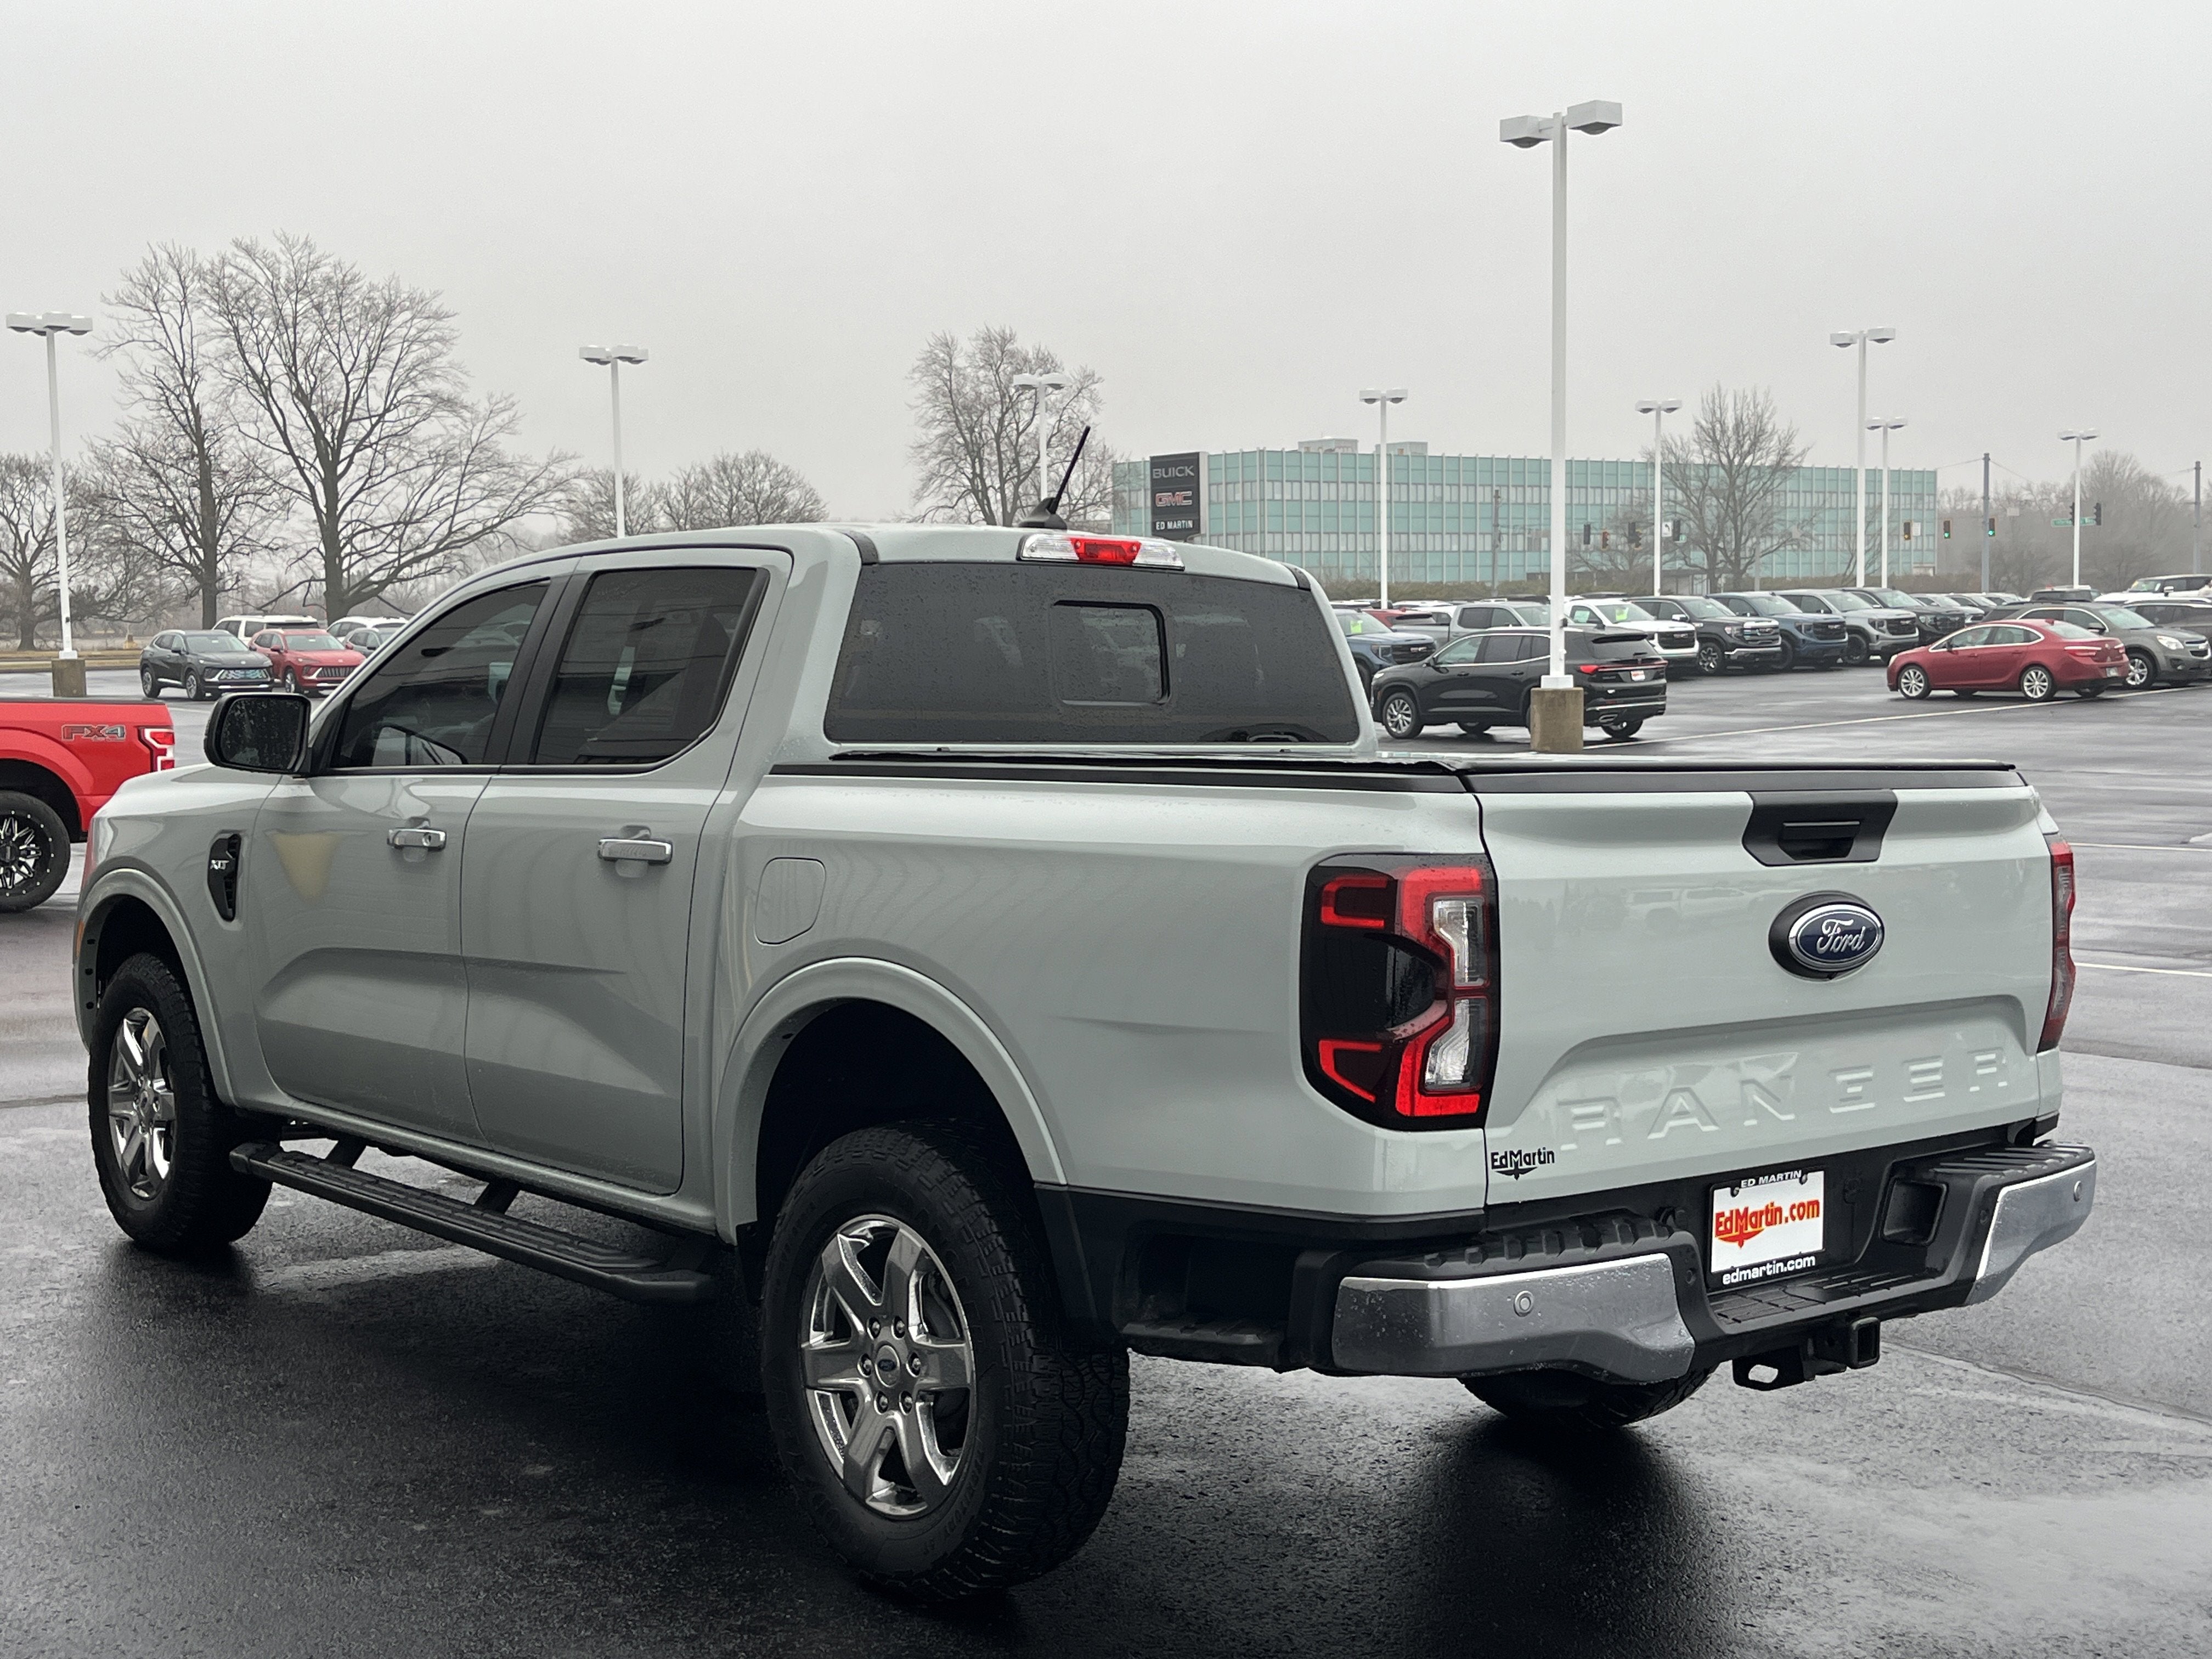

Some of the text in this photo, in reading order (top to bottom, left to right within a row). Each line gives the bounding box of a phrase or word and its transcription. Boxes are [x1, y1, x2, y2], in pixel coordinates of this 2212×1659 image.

[1153, 465, 1195, 478] BUICK
[1155, 490, 1192, 507] GMC
[1156, 520, 1193, 531] ED MARTIN
[61, 724, 126, 741] FX4
[1816, 919, 1866, 955] Ford
[1556, 1047, 2009, 1151] RANGER
[1491, 1147, 1555, 1170] EdMartin
[1740, 1170, 1802, 1189] ED MARTIN
[1715, 1199, 1820, 1238] EdMartin.com
[1722, 1255, 1816, 1285] edmartin.com
